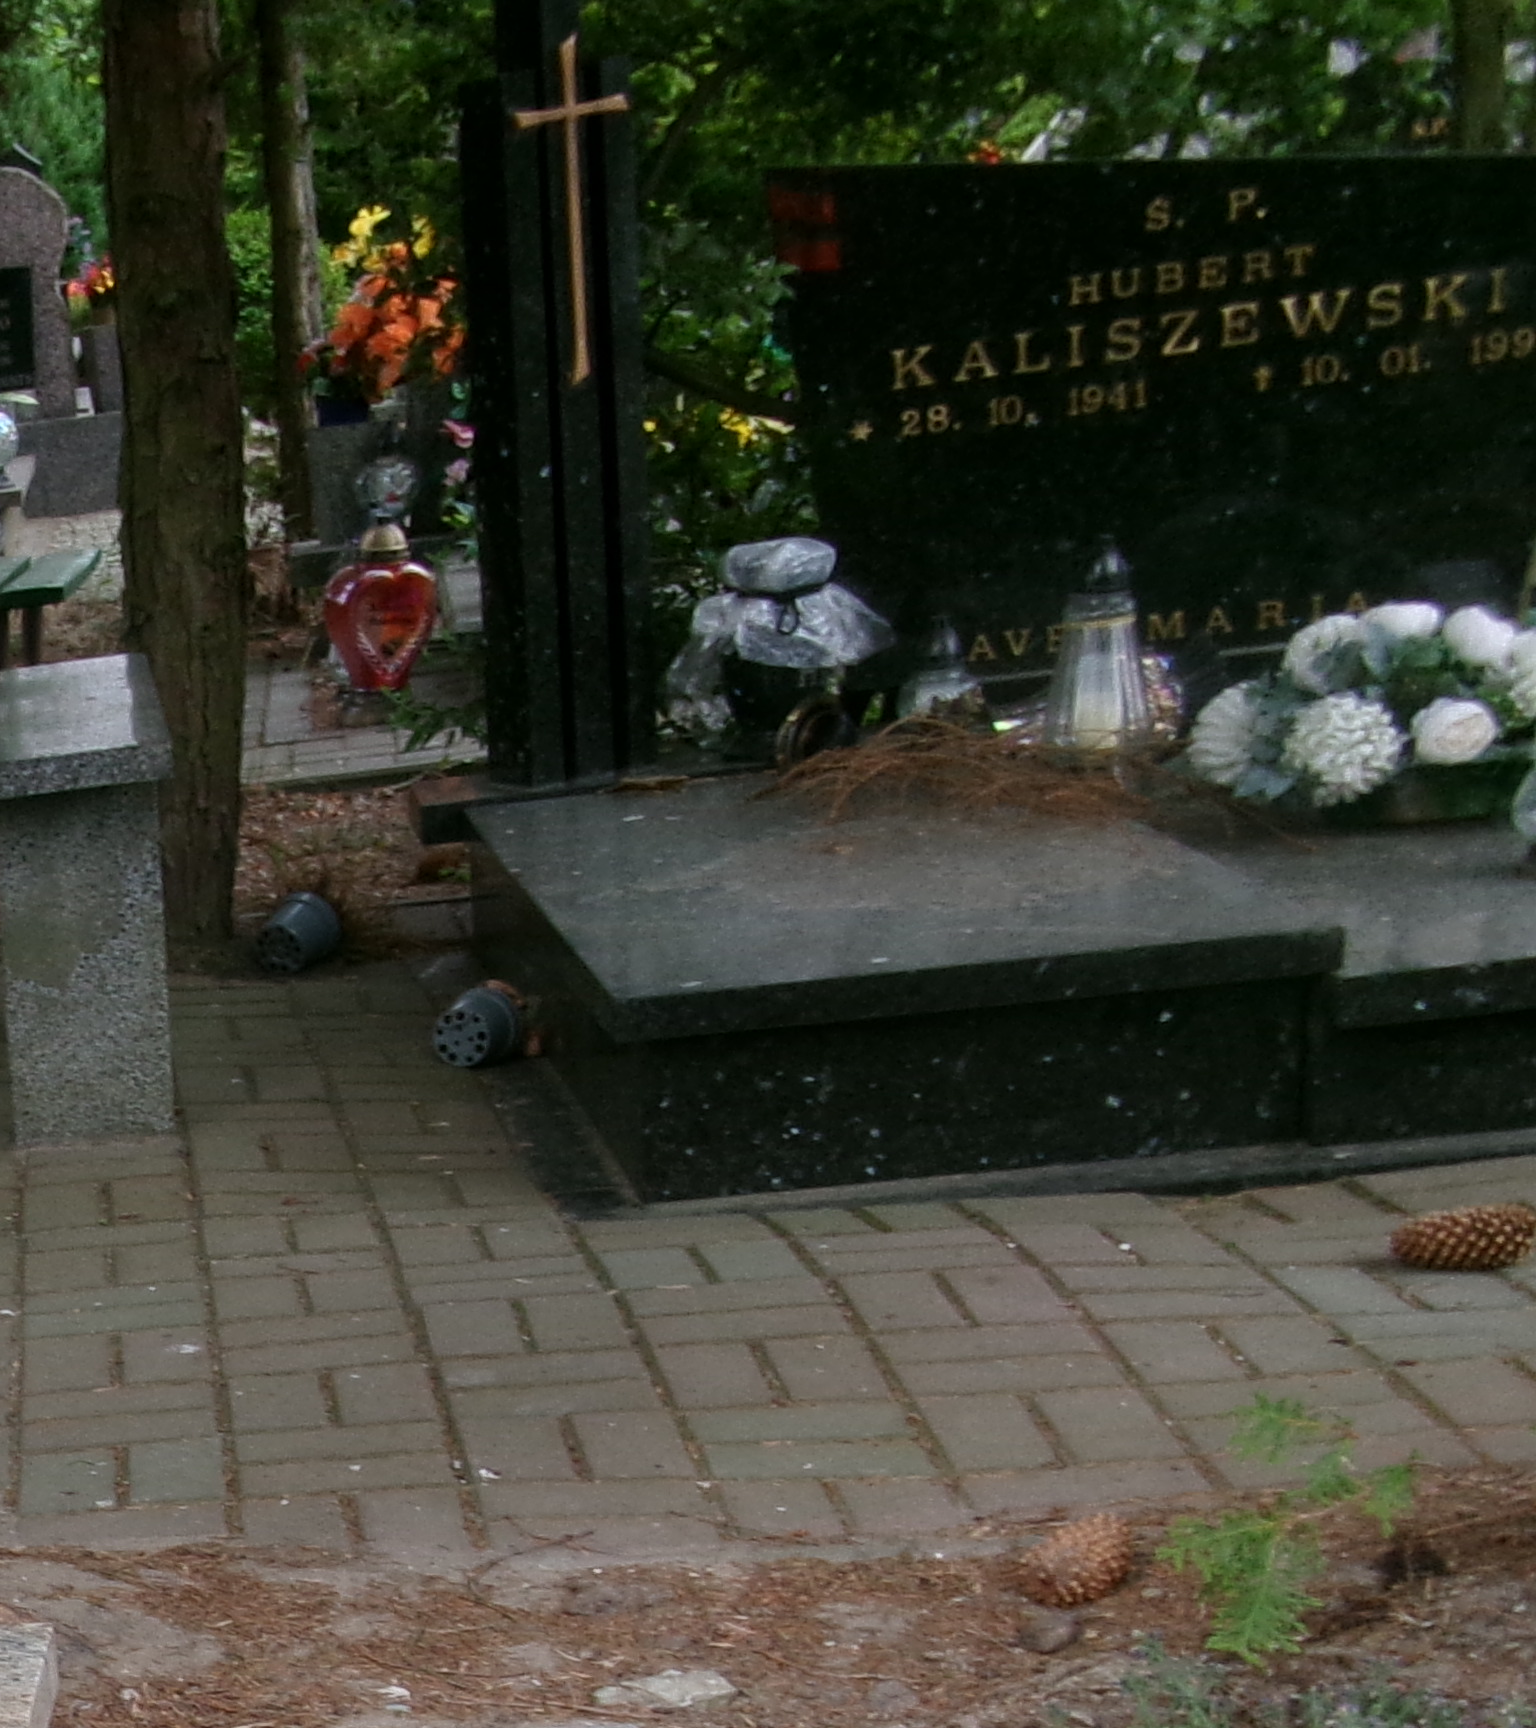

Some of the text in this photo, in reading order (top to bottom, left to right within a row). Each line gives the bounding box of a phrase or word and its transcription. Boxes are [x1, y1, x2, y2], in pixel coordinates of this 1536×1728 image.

[1068, 243, 1318, 306] HUBERT
[891, 267, 1508, 391] KALISZEWSKI
[1067, 379, 1147, 416] 1941
[1469, 327, 1536, 366] 199
